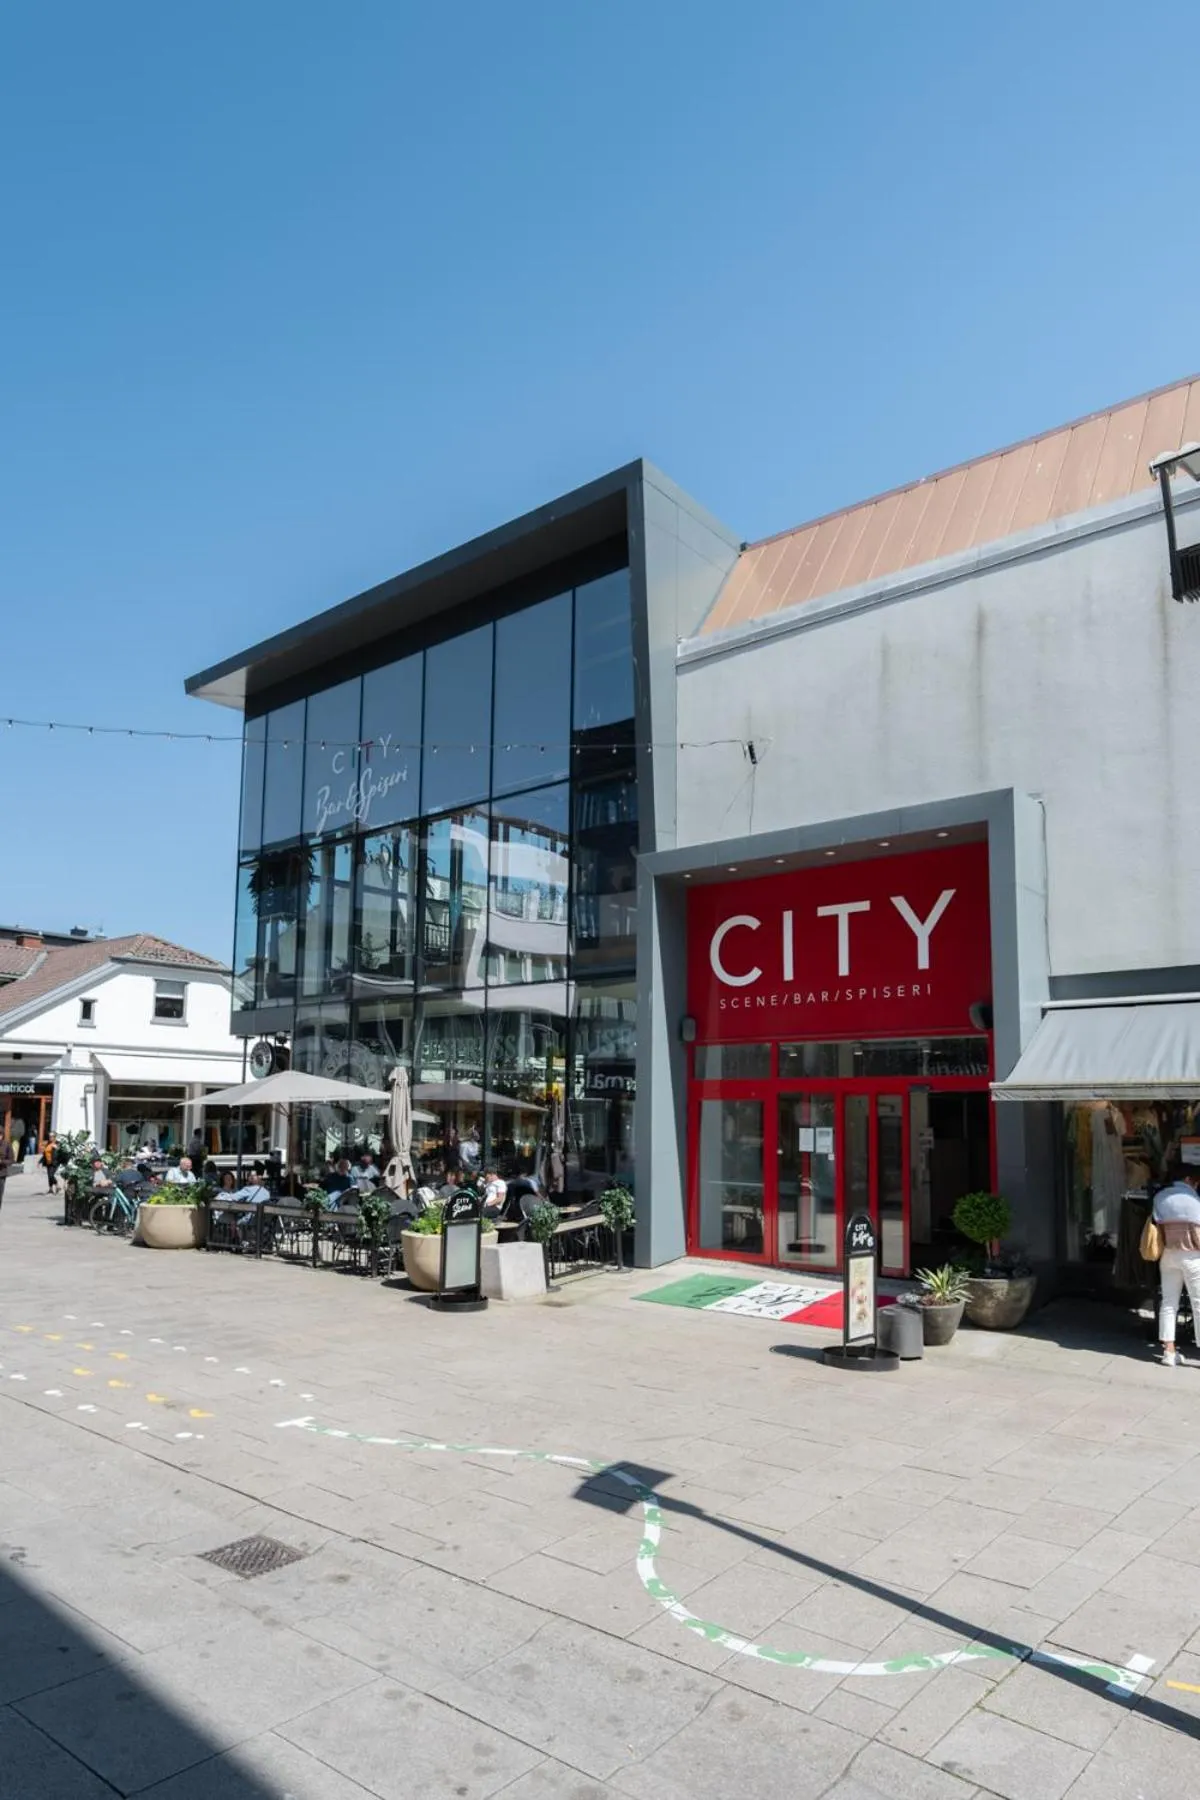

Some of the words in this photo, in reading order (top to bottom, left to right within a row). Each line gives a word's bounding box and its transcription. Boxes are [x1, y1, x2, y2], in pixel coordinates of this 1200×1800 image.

[332, 733, 392, 774] CITY
[710, 888, 956, 987] CITY
[719, 983, 932, 1009] SCENE/BAR/SPISERI
